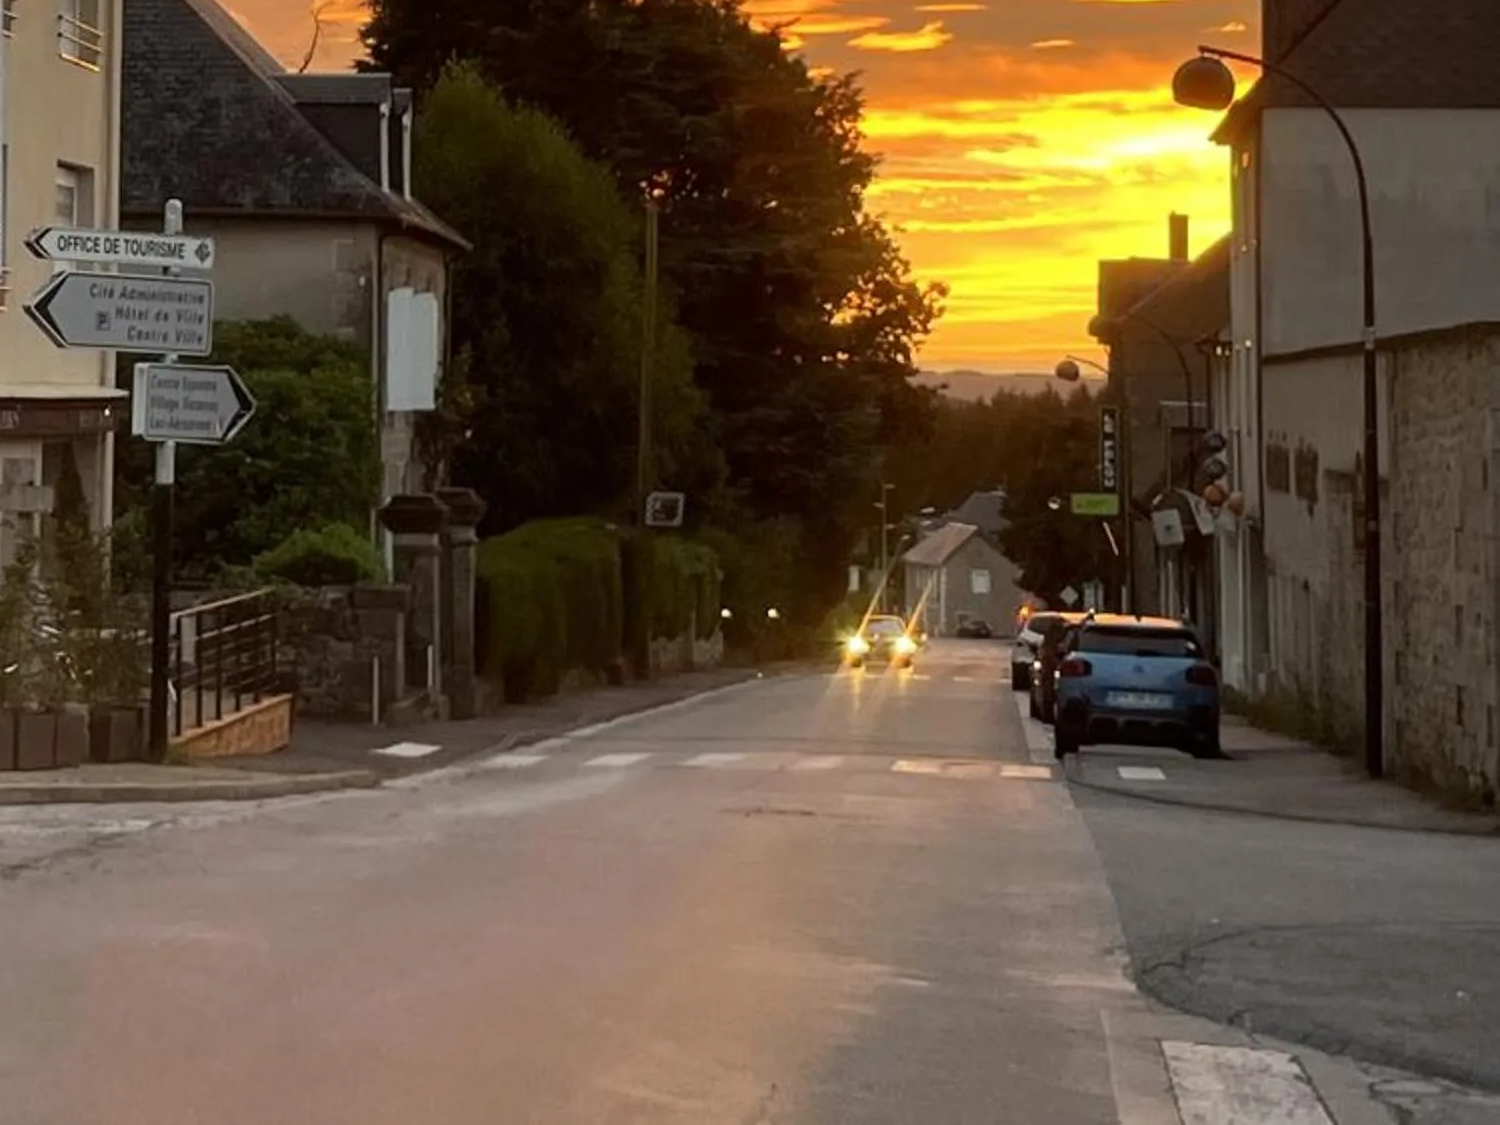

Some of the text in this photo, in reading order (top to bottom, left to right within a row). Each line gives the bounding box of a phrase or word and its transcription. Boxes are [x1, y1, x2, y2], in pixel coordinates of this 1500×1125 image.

[57, 234, 186, 260] OFFICE DE TOURISME
[115, 305, 204, 325] Hôtel de Ville
[126, 324, 203, 345] Centre Ville
